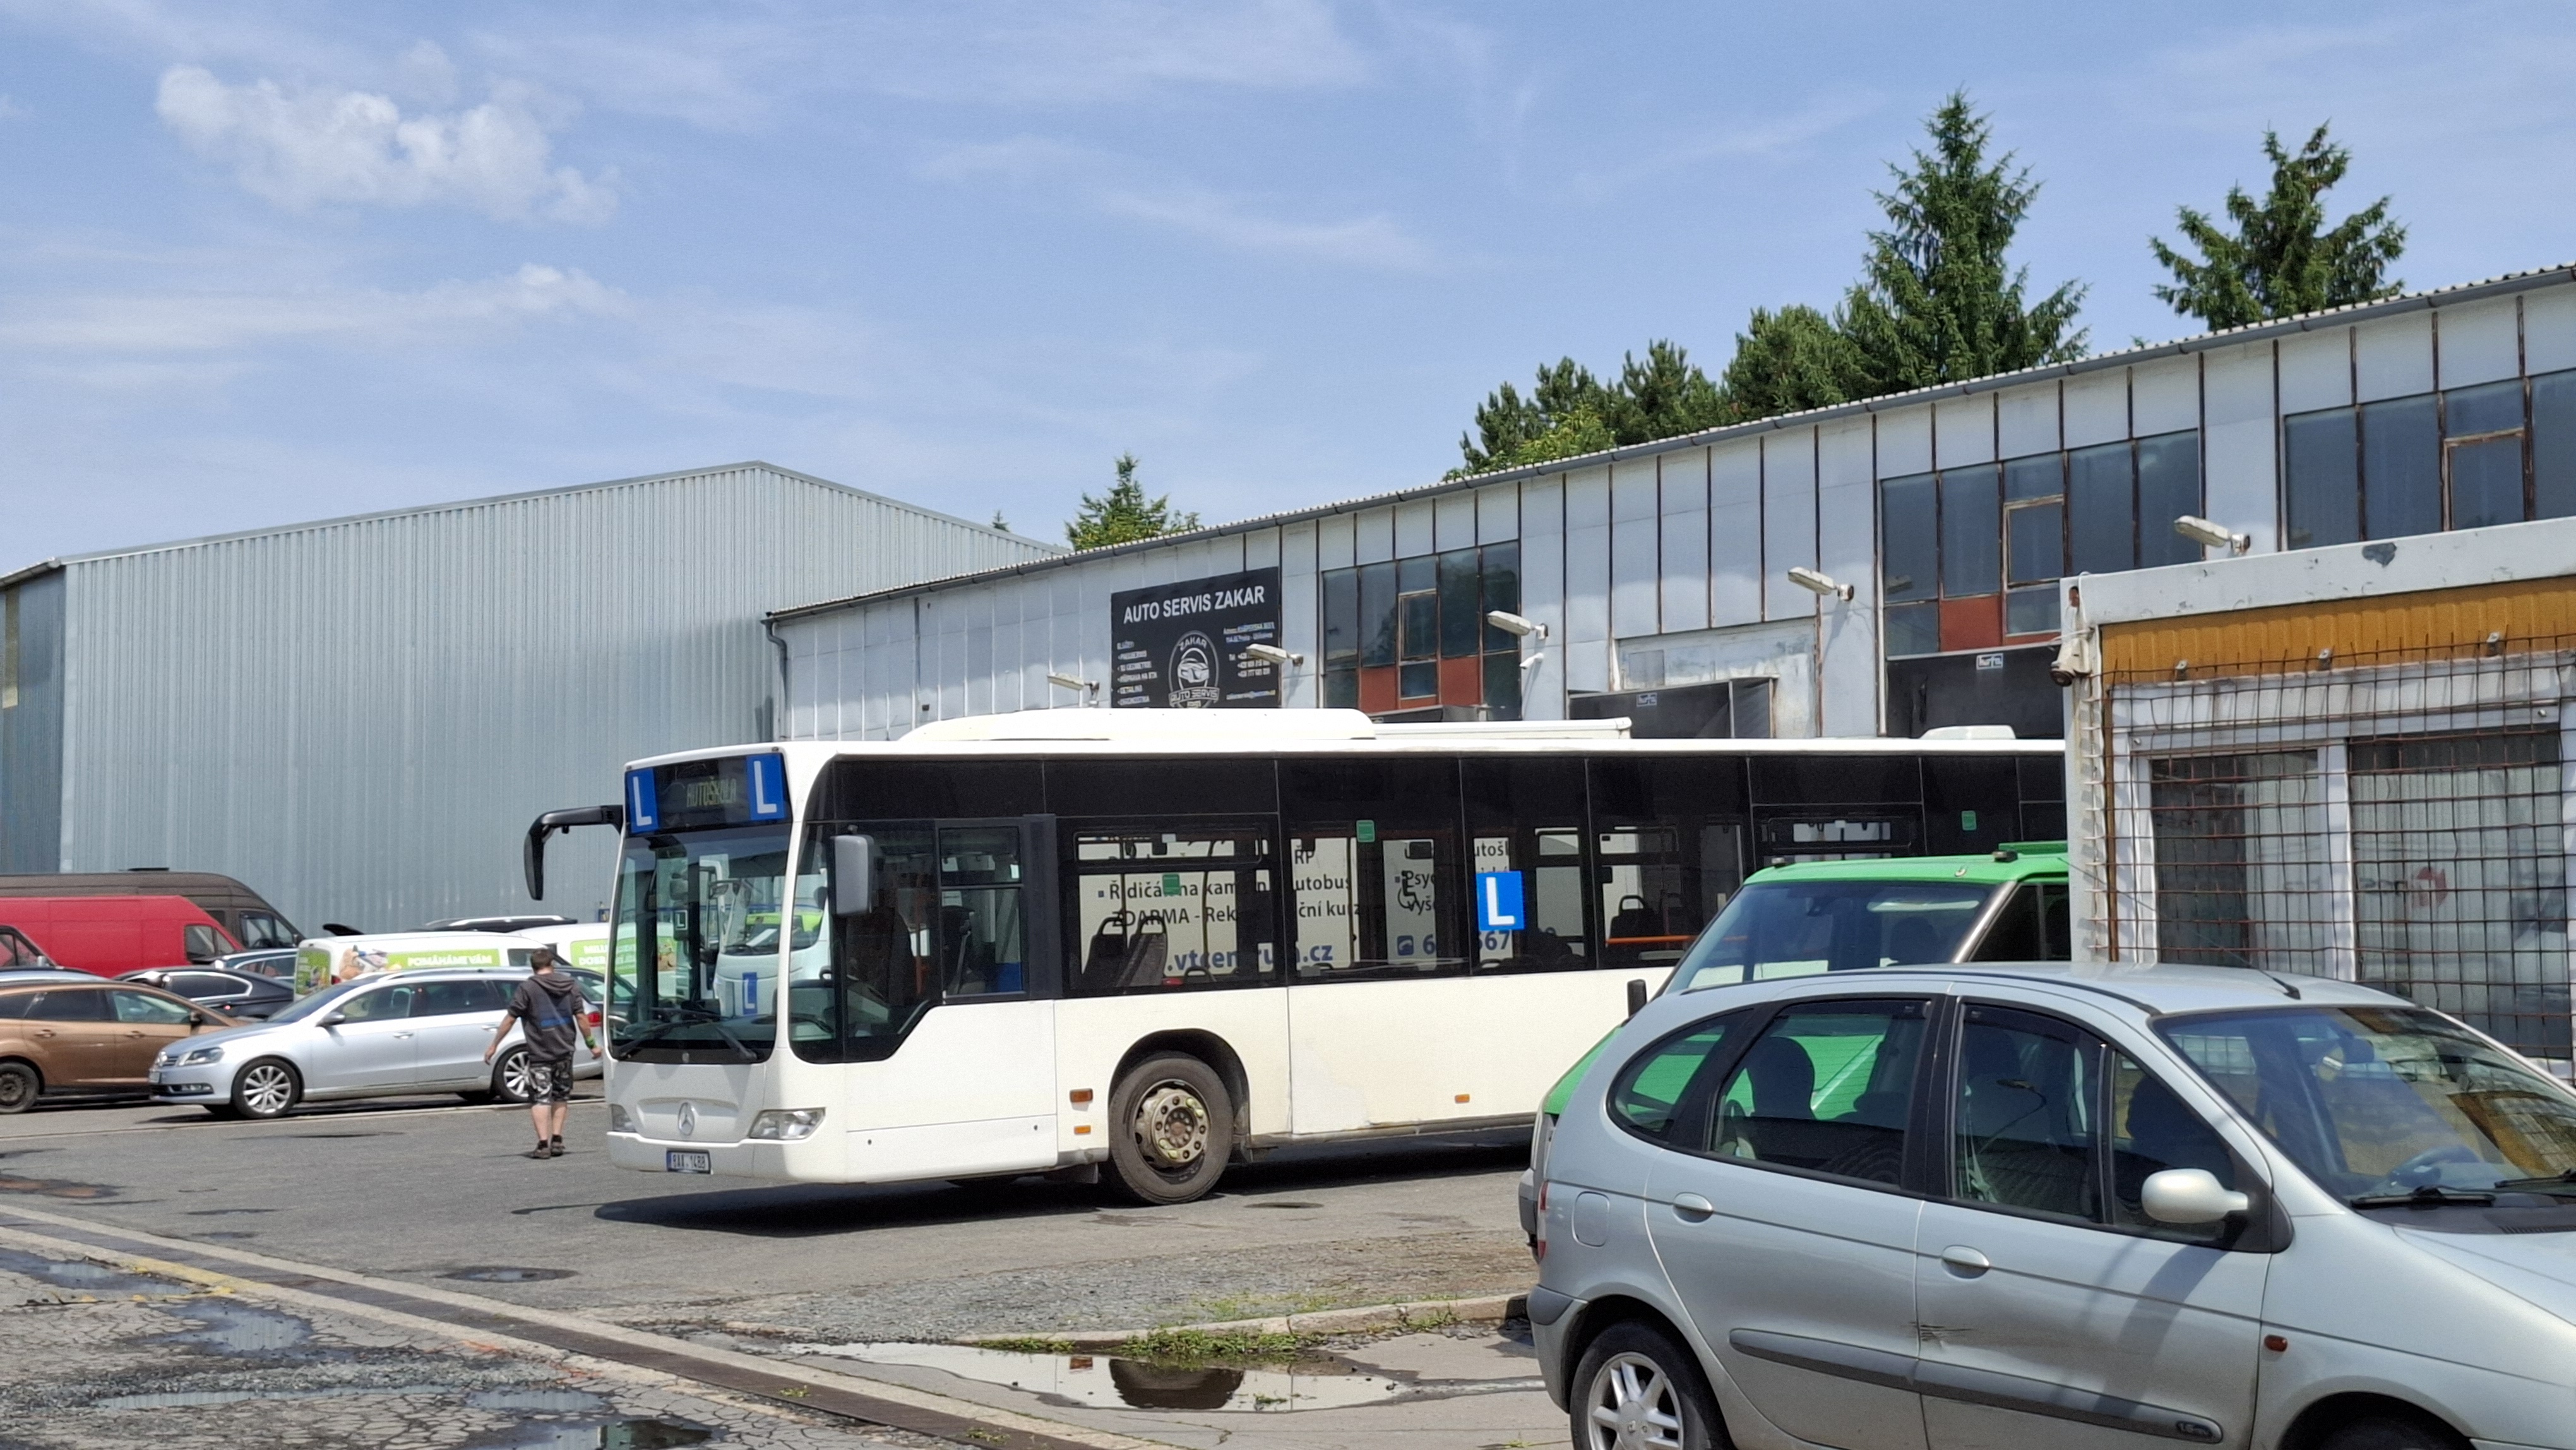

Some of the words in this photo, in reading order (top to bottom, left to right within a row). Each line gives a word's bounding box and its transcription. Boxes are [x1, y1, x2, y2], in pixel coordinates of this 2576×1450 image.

[1124, 602, 1160, 624] AUTO
[1163, 594, 1212, 618] SERVIS
[1215, 585, 1265, 610] ZAKAR
[1179, 637, 1208, 651] ZAKAR
[1171, 690, 1190, 702] AUTO
[1191, 688, 1218, 698] SERVIS
[633, 776, 652, 827] L
[753, 760, 777, 814] L
[1486, 877, 1515, 926] L
